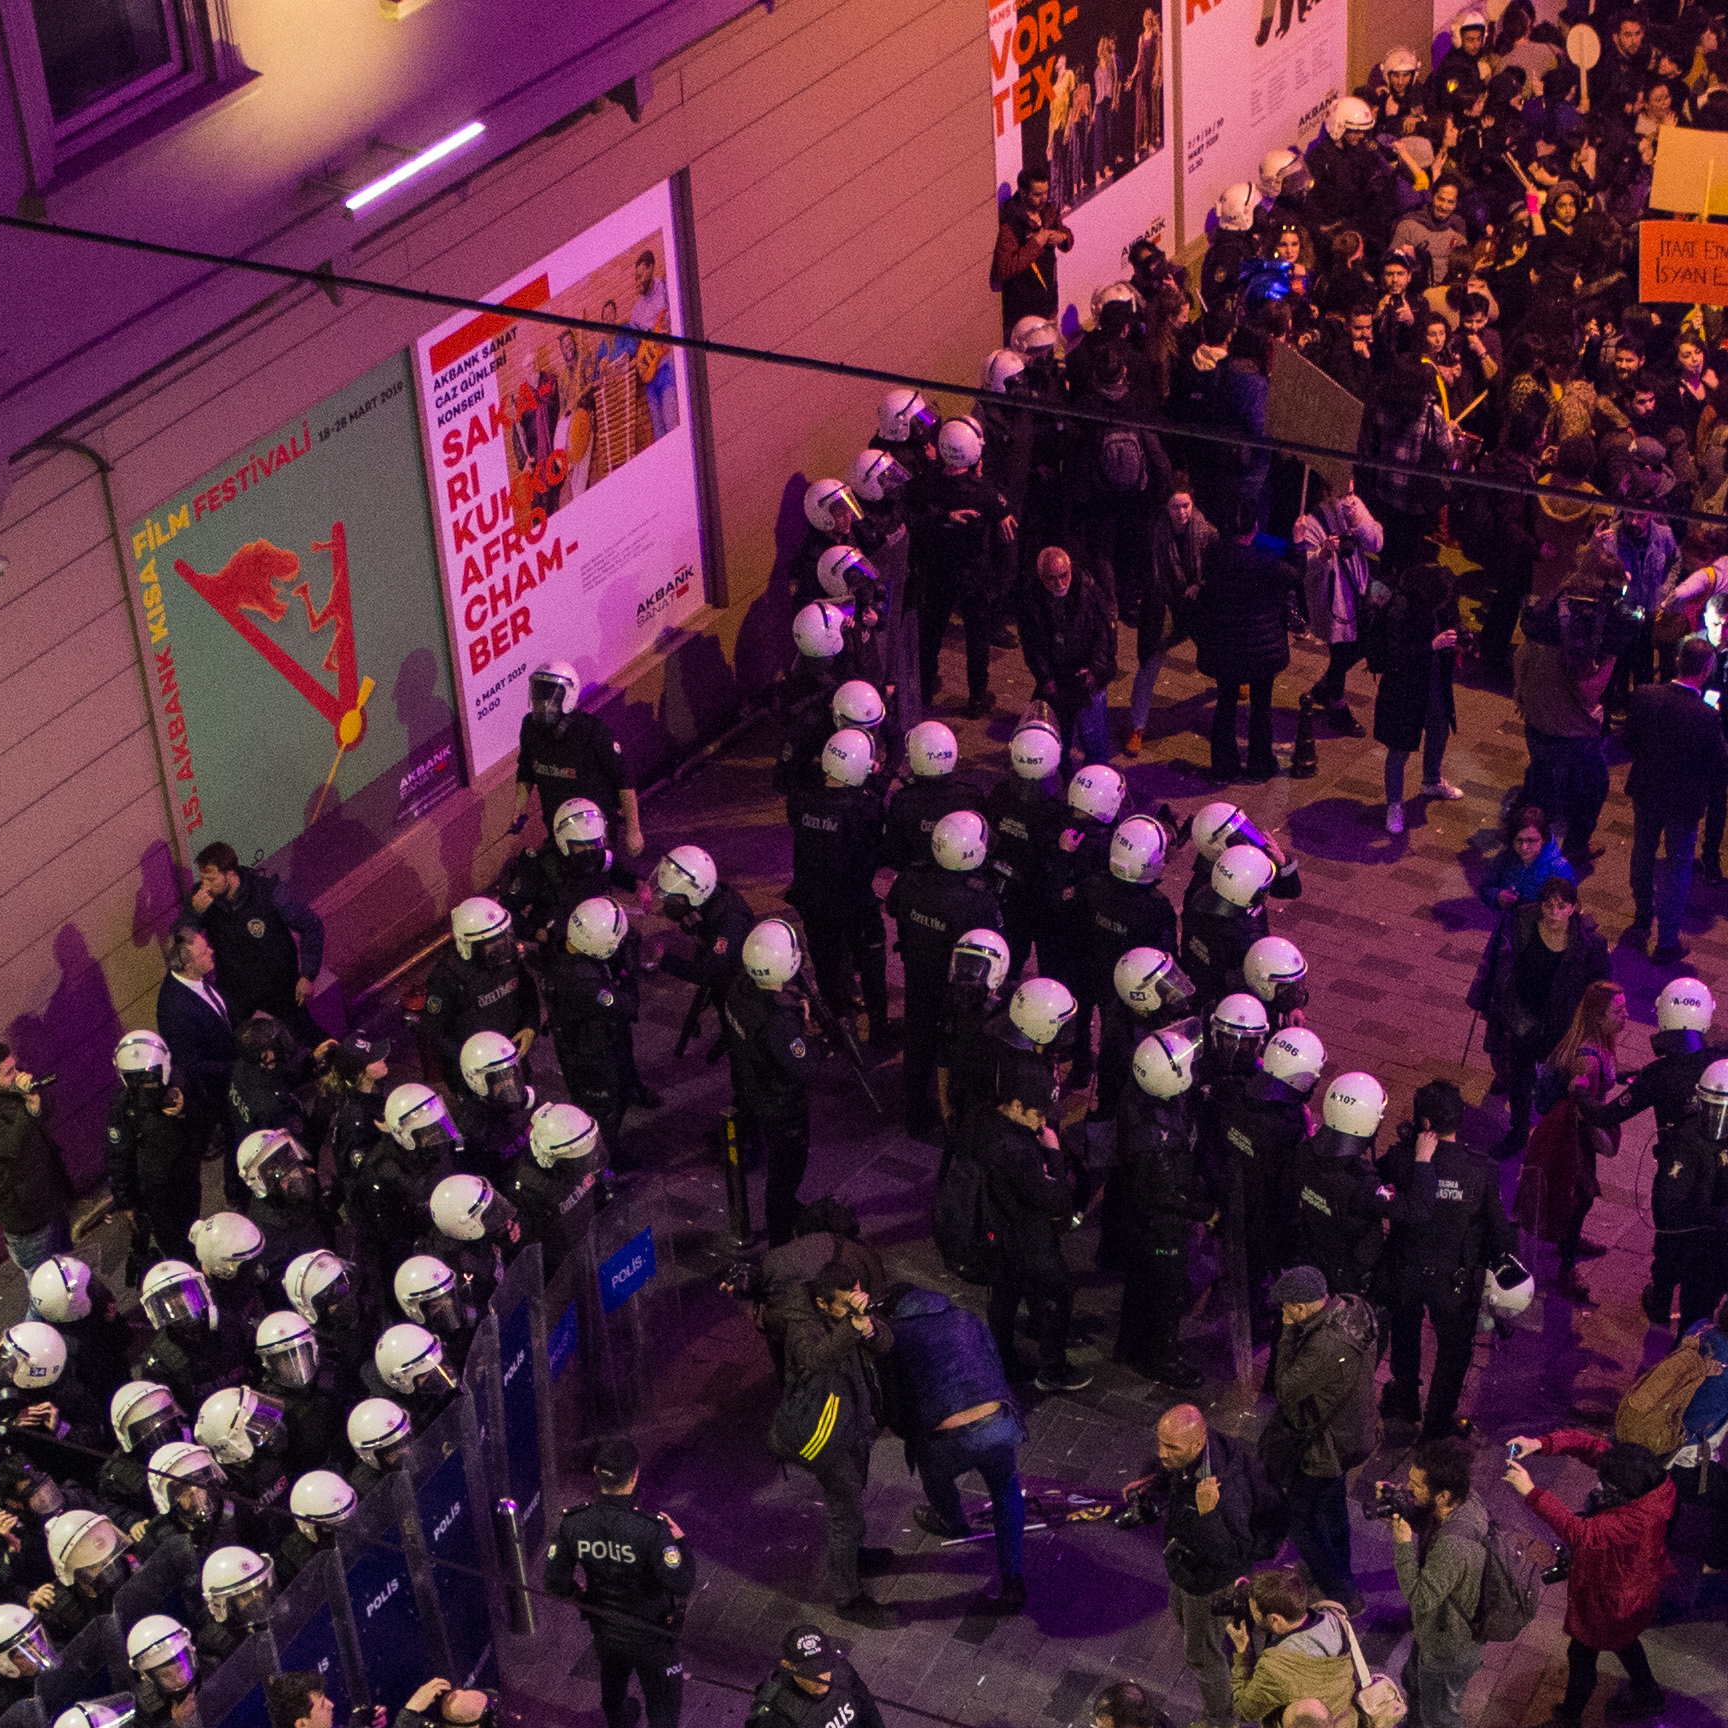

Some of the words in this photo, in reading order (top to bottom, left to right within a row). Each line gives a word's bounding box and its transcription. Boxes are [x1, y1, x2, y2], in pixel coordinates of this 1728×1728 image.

[992, 55, 1057, 138] TEX
[433, 350, 480, 392] AKBANK
[482, 326, 519, 360] SANAT
[192, 418, 313, 523] FESTİVALİ
[132, 503, 191, 560] FİLM
[460, 505, 549, 598] AFRO
[139, 557, 169, 644] KISA
[464, 537, 580, 632] CHAM-
[636, 564, 695, 617] AKBANK
[468, 605, 534, 677] BER
[154, 643, 196, 781] AKBANK
[365, 1577, 400, 1618] POLİS
